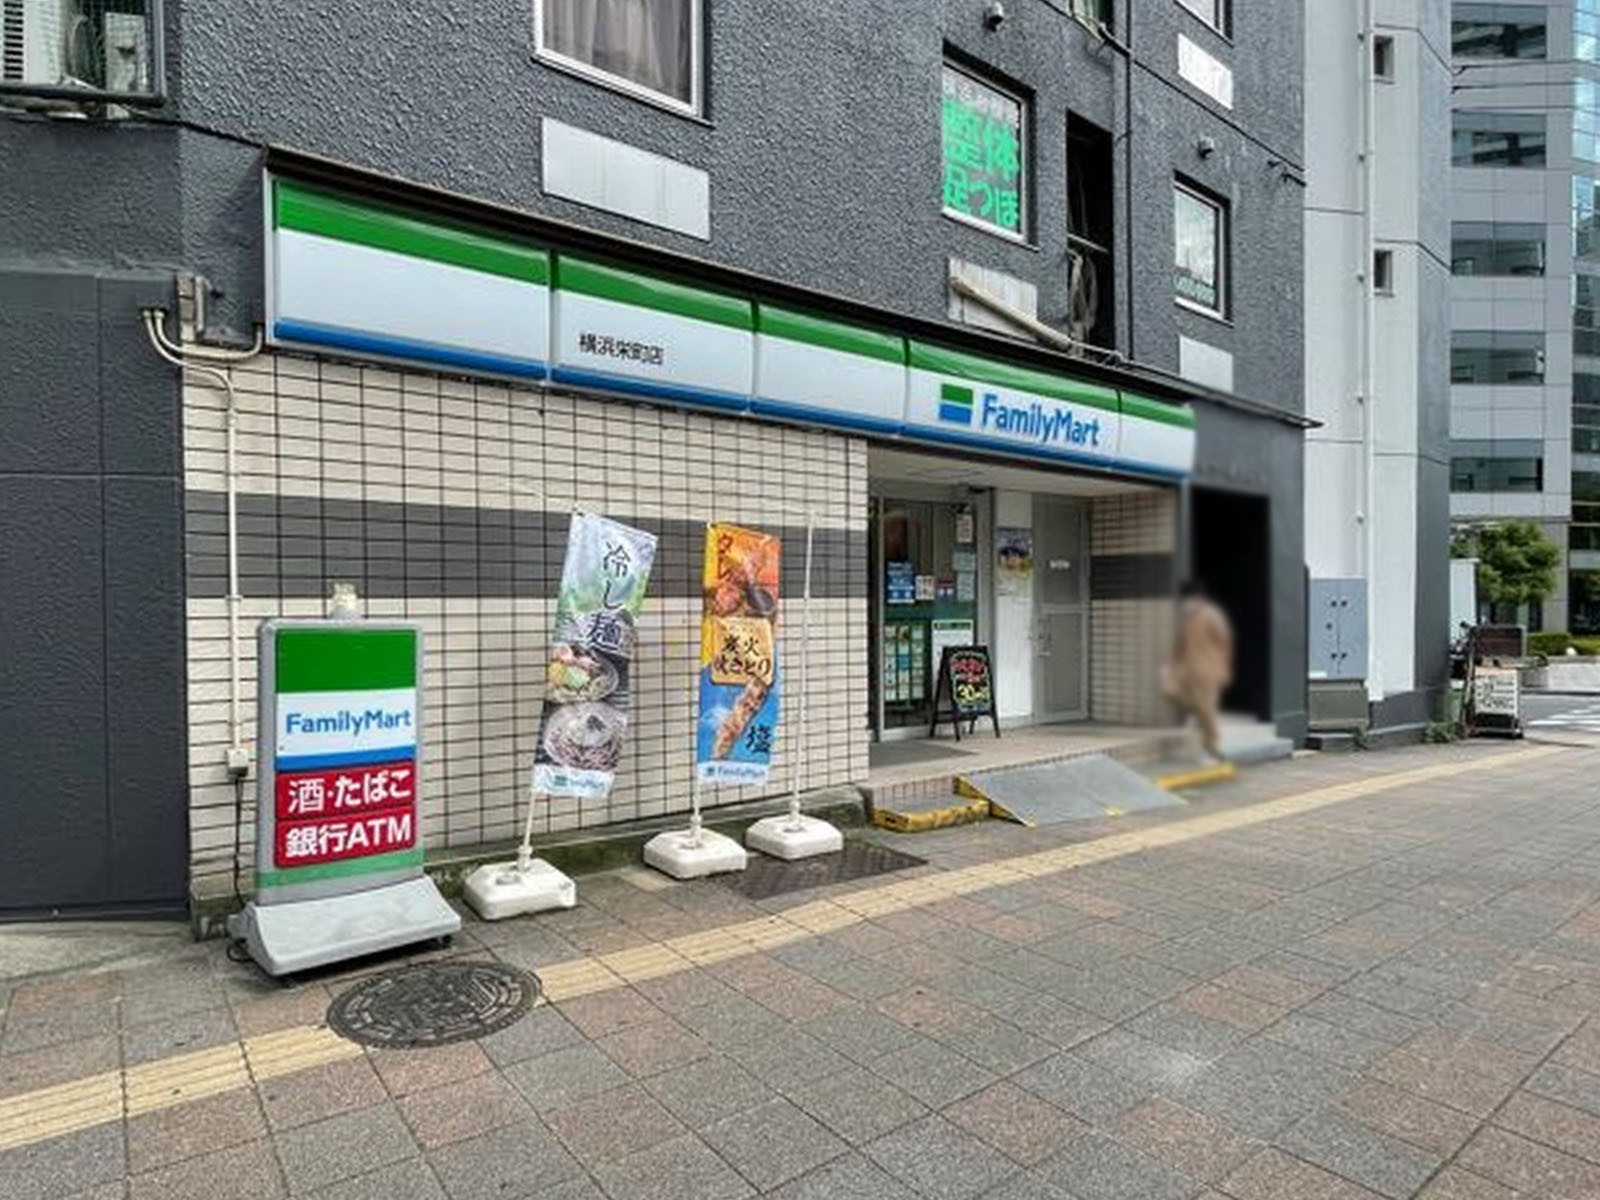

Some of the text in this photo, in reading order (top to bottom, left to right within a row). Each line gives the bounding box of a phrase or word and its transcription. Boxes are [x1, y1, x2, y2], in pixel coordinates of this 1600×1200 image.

[580, 333, 664, 365] 横浜栄町店
[983, 393, 1099, 446] FamilyMart
[286, 708, 412, 737] FamilyMart
[745, 725, 772, 754] 塩
[288, 768, 412, 813] 酒・たばこ
[285, 815, 411, 859] 銀行ATM
